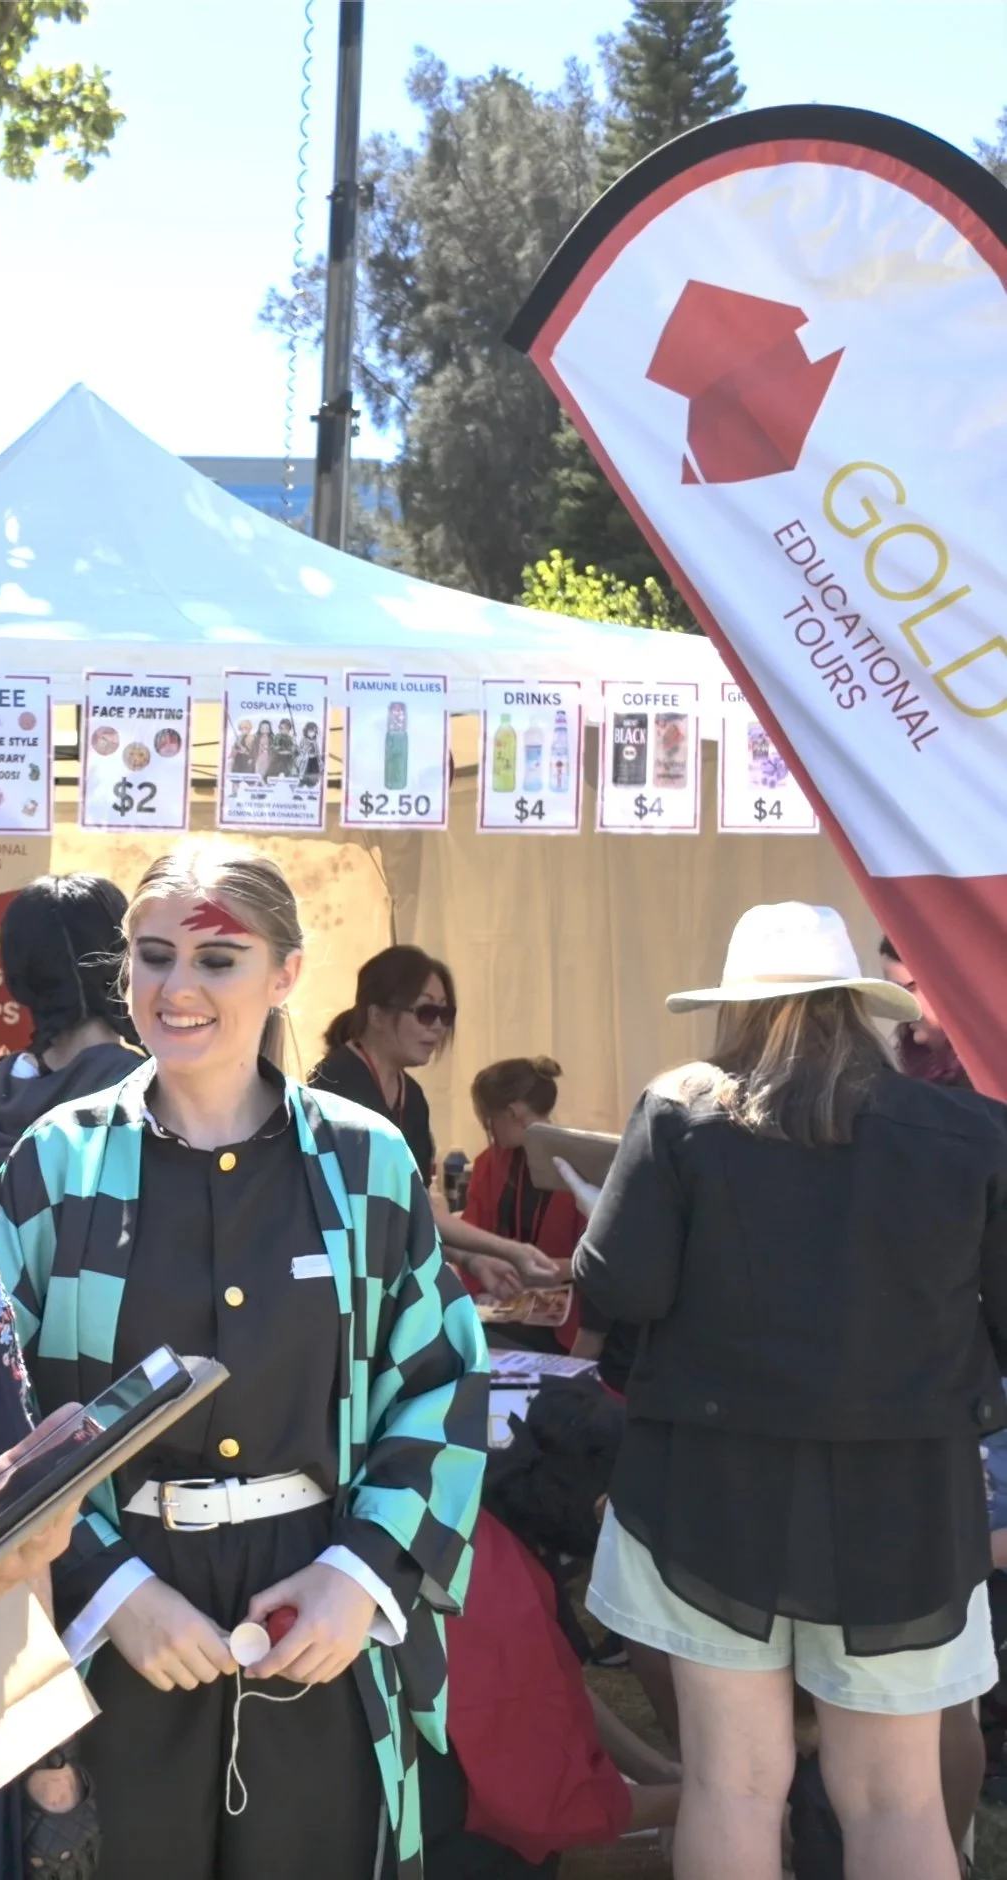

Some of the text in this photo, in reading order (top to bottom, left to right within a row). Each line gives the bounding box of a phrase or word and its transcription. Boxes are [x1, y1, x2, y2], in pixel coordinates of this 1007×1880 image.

[822, 461, 1007, 718] GOLD
[773, 519, 939, 753] EDUCATIONAL
[783, 595, 867, 710] TOURS
[106, 685, 170, 698] JAPANESE
[256, 681, 297, 697] FREE
[353, 681, 441, 693] RAMUNE LOLLIES
[240, 701, 314, 712] COSPLAY PHOTO
[504, 692, 562, 706] DRINKS
[622, 693, 679, 707] COFFEE
[92, 706, 184, 720] FACE PAINTING
[8, 737, 39, 747] STYLE
[614, 727, 646, 744] BLACK
[112, 776, 158, 817] $2
[359, 791, 431, 818] $2.50
[514, 797, 546, 823] $4
[634, 793, 664, 820] $4
[754, 797, 783, 823] $4
